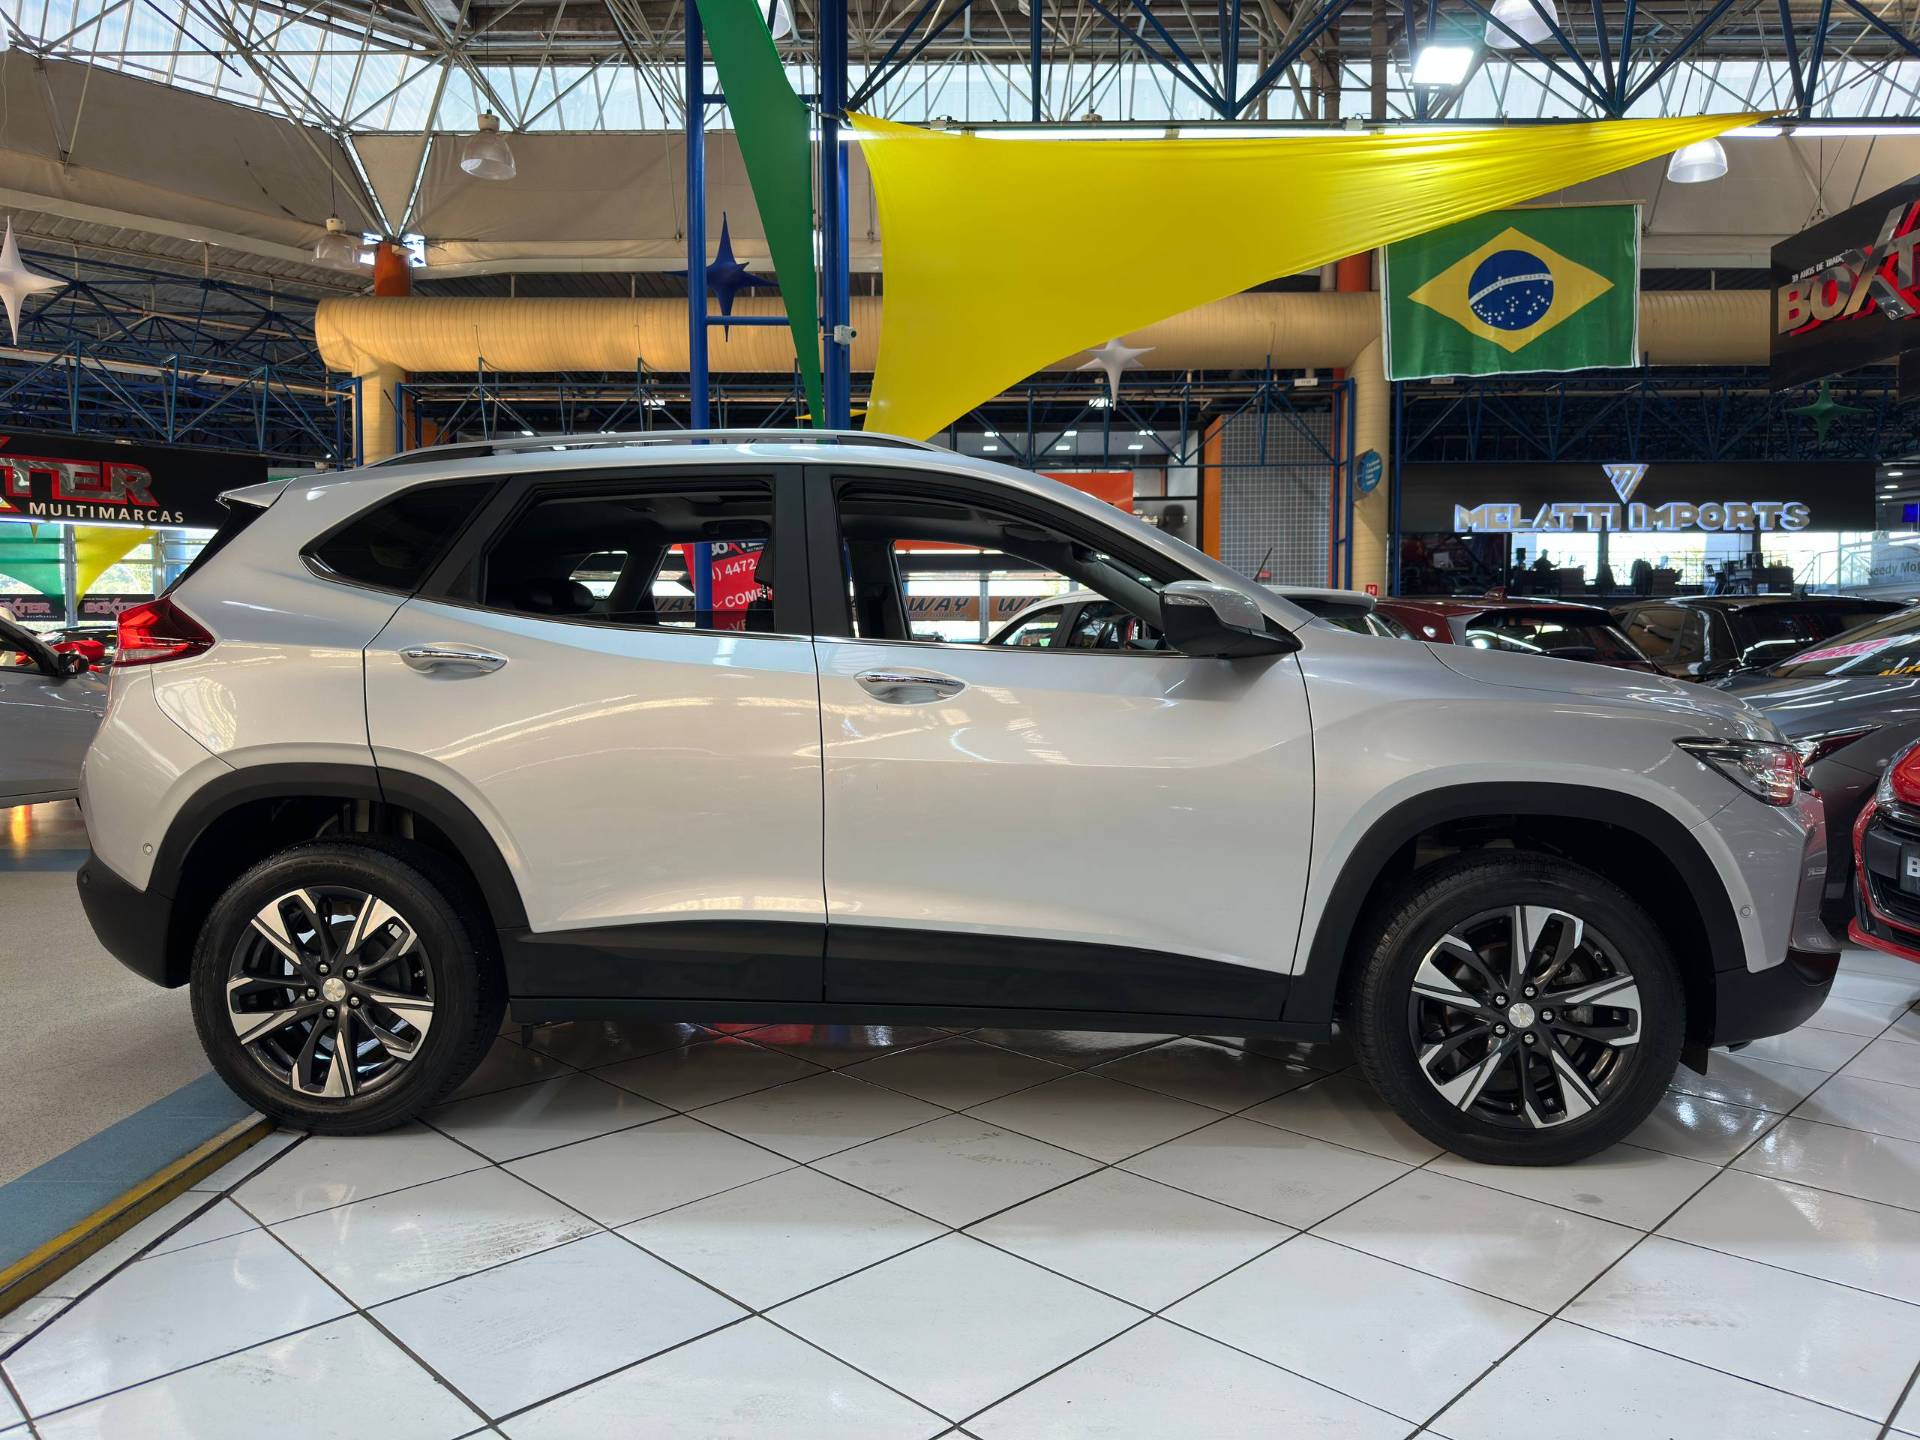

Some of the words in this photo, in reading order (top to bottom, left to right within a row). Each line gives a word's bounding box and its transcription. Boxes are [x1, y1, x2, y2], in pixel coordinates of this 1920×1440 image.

[29, 502, 184, 523] MULTIMARCAS
[1454, 503, 1621, 532] MELATTI
[1628, 502, 1811, 531] IMPORTS
[725, 558, 757, 576] 4472
[909, 597, 968, 612] WAY
